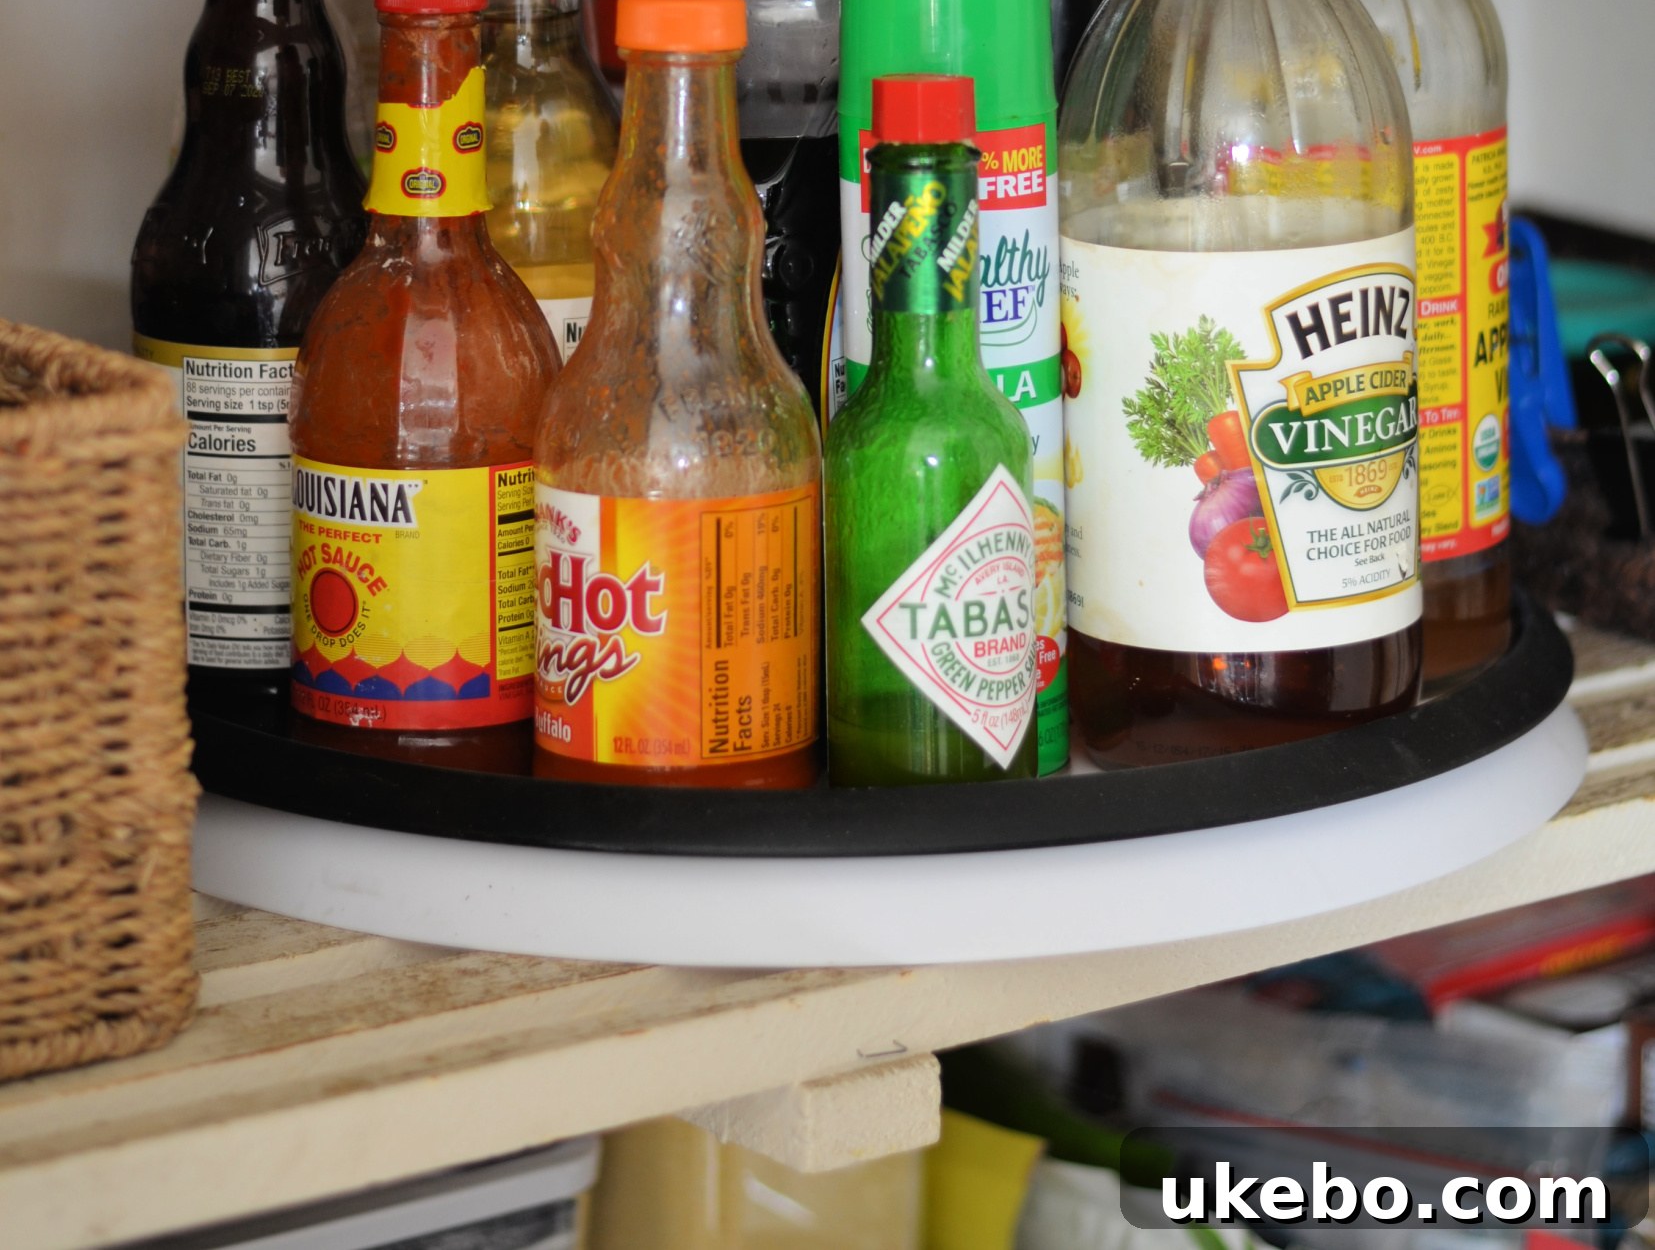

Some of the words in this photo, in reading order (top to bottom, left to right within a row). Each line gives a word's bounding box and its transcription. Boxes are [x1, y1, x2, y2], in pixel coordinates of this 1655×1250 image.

[1003, 145, 1043, 174] MORE
[979, 170, 1043, 200] FREE
[981, 286, 1031, 324] EF
[1421, 298, 1458, 317] DRINK
[1285, 285, 1410, 360] HEINZ
[186, 360, 253, 379] Nutrition
[259, 363, 294, 379] Fact
[186, 382, 197, 393] 88
[199, 385, 237, 398] servings
[240, 388, 255, 398] per
[1305, 374, 1365, 407] APPLE
[1370, 370, 1408, 389] CIDER
[187, 396, 222, 411] Serving
[224, 400, 243, 410] size
[250, 400, 254, 409] 1
[258, 400, 274, 412] tsp
[226, 426, 252, 434] Serving
[1268, 396, 1418, 455] VINEGAR
[188, 432, 257, 453] Calories
[188, 470, 207, 480] Total
[209, 472, 222, 481] Fat
[227, 473, 238, 484] 0g
[1344, 459, 1388, 487] 1869
[200, 485, 239, 496] Saturated
[241, 488, 252, 496] fat
[257, 488, 268, 498] 0g
[498, 488, 521, 500] Serving
[201, 498, 222, 508] Trans
[223, 500, 234, 509] fat
[239, 501, 250, 511] 0g
[188, 511, 234, 522] Cholesterol
[240, 514, 259, 526] 0mg
[1307, 528, 1338, 543] THE
[1340, 524, 1364, 540] ALL
[1367, 509, 1411, 535] NATURAL
[188, 524, 218, 534] Sodium
[223, 527, 248, 538] 65mg
[299, 520, 315, 535] THE
[318, 526, 383, 544] PERFECT
[395, 530, 420, 539] BRAND
[498, 526, 524, 538] Amount
[724, 521, 733, 538] 0%
[188, 537, 207, 547] Total
[209, 538, 231, 549] Carb.
[237, 541, 247, 551] 1g
[498, 539, 524, 550] Calories
[525, 536, 530, 545] 0
[1307, 541, 1360, 562] CHOICE
[1364, 535, 1387, 553] FOR
[1389, 525, 1412, 546] FOOD
[200, 550, 228, 563] Dietary
[230, 552, 251, 562] Fiber
[256, 554, 268, 565] 0g
[1354, 557, 1368, 567] See
[1369, 552, 1385, 563] Back
[201, 564, 218, 575] Total
[221, 566, 250, 578] Sugars
[256, 567, 266, 579] 1g
[297, 544, 317, 582] HOT
[321, 541, 388, 597] SAUCE
[498, 569, 516, 580] Total
[209, 579, 236, 588] Includes
[741, 572, 751, 585] 0g
[1342, 578, 1357, 589] 5%
[1359, 568, 1391, 585] ACIDITY
[189, 589, 218, 601] Protein
[222, 592, 233, 603] 0g
[498, 583, 526, 594] Sodium
[724, 585, 736, 598] 0g
[740, 588, 750, 605] Fat
[498, 599, 516, 609] Total
[724, 601, 733, 618] Fat
[498, 611, 524, 624] Protein
[740, 607, 750, 637] Trans
[756, 603, 765, 644] Sodium
[311, 626, 336, 648] DROP
[340, 621, 367, 648] DOES
[361, 605, 372, 619] IT
[724, 622, 733, 648] Total
[771, 615, 779, 642] Total
[499, 633, 524, 645] Vitamin
[973, 632, 1026, 659] BRAND
[1039, 650, 1057, 664] Free
[931, 641, 976, 693] GREEN
[976, 670, 1026, 701] PEPPER
[708, 660, 729, 753] Nutrition
[733, 695, 752, 752] Facts
[761, 712, 769, 728] Size
[971, 709, 980, 723] 5
[773, 713, 782, 746] Servings
[613, 736, 624, 753] 12
[652, 737, 673, 756] (354
